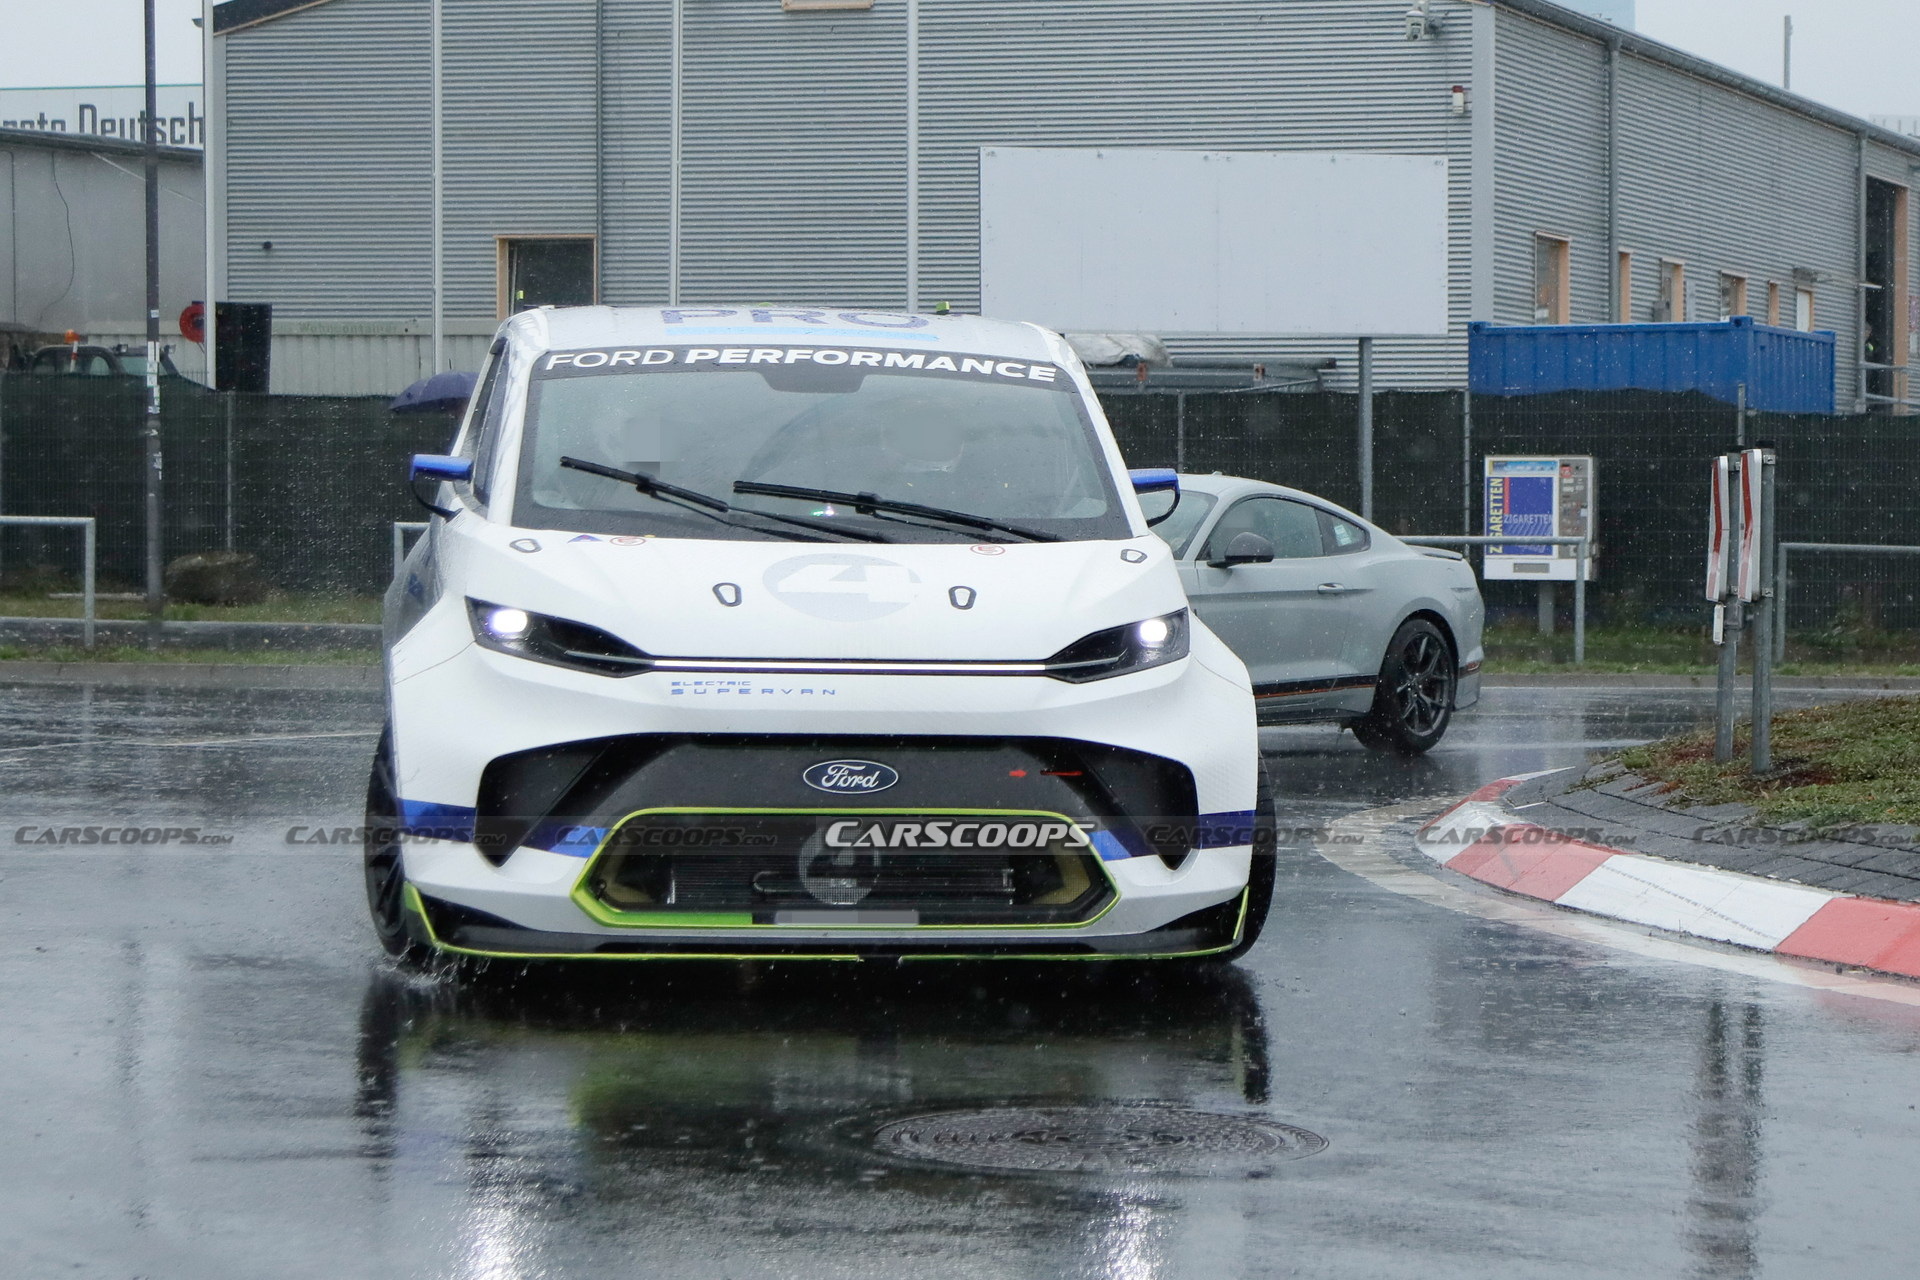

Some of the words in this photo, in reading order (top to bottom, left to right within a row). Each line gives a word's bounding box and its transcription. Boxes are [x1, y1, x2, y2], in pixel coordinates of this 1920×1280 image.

[660, 308, 929, 329] PRO
[546, 349, 674, 370] FORD
[684, 348, 1057, 382] PERFORMANCE
[670, 688, 836, 696] SUPERVAN
[821, 763, 881, 788] Ford
